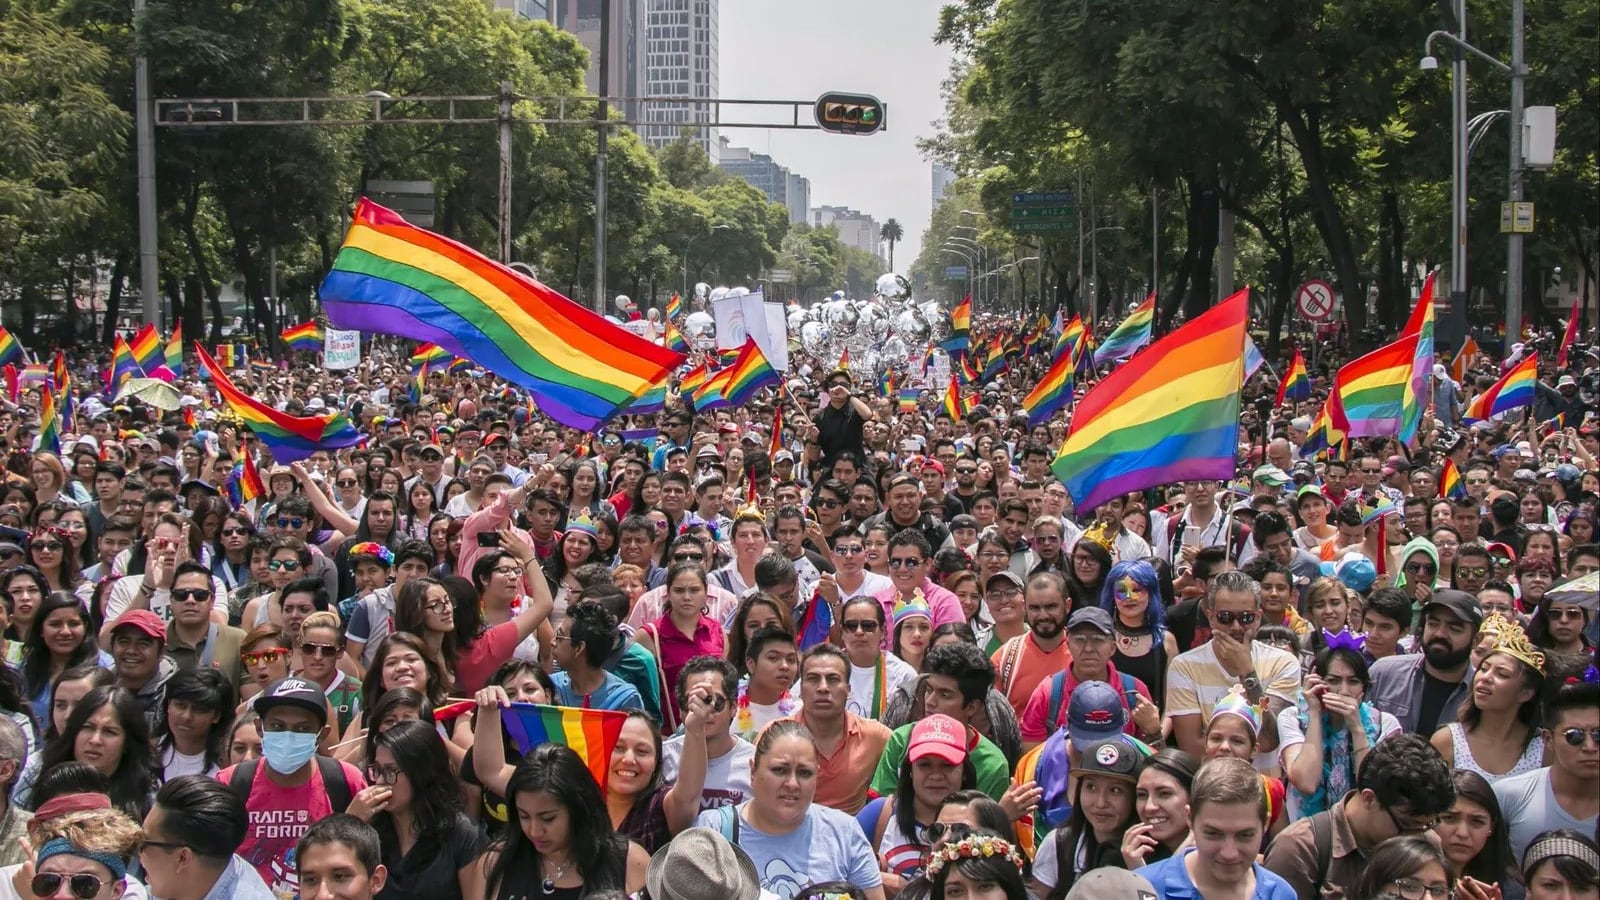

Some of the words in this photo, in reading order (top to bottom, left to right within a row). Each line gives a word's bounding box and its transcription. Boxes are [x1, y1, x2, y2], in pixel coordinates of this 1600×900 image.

[279, 679, 306, 690] NIKE
[248, 810, 294, 824] RANS
[255, 824, 309, 839] FORM
